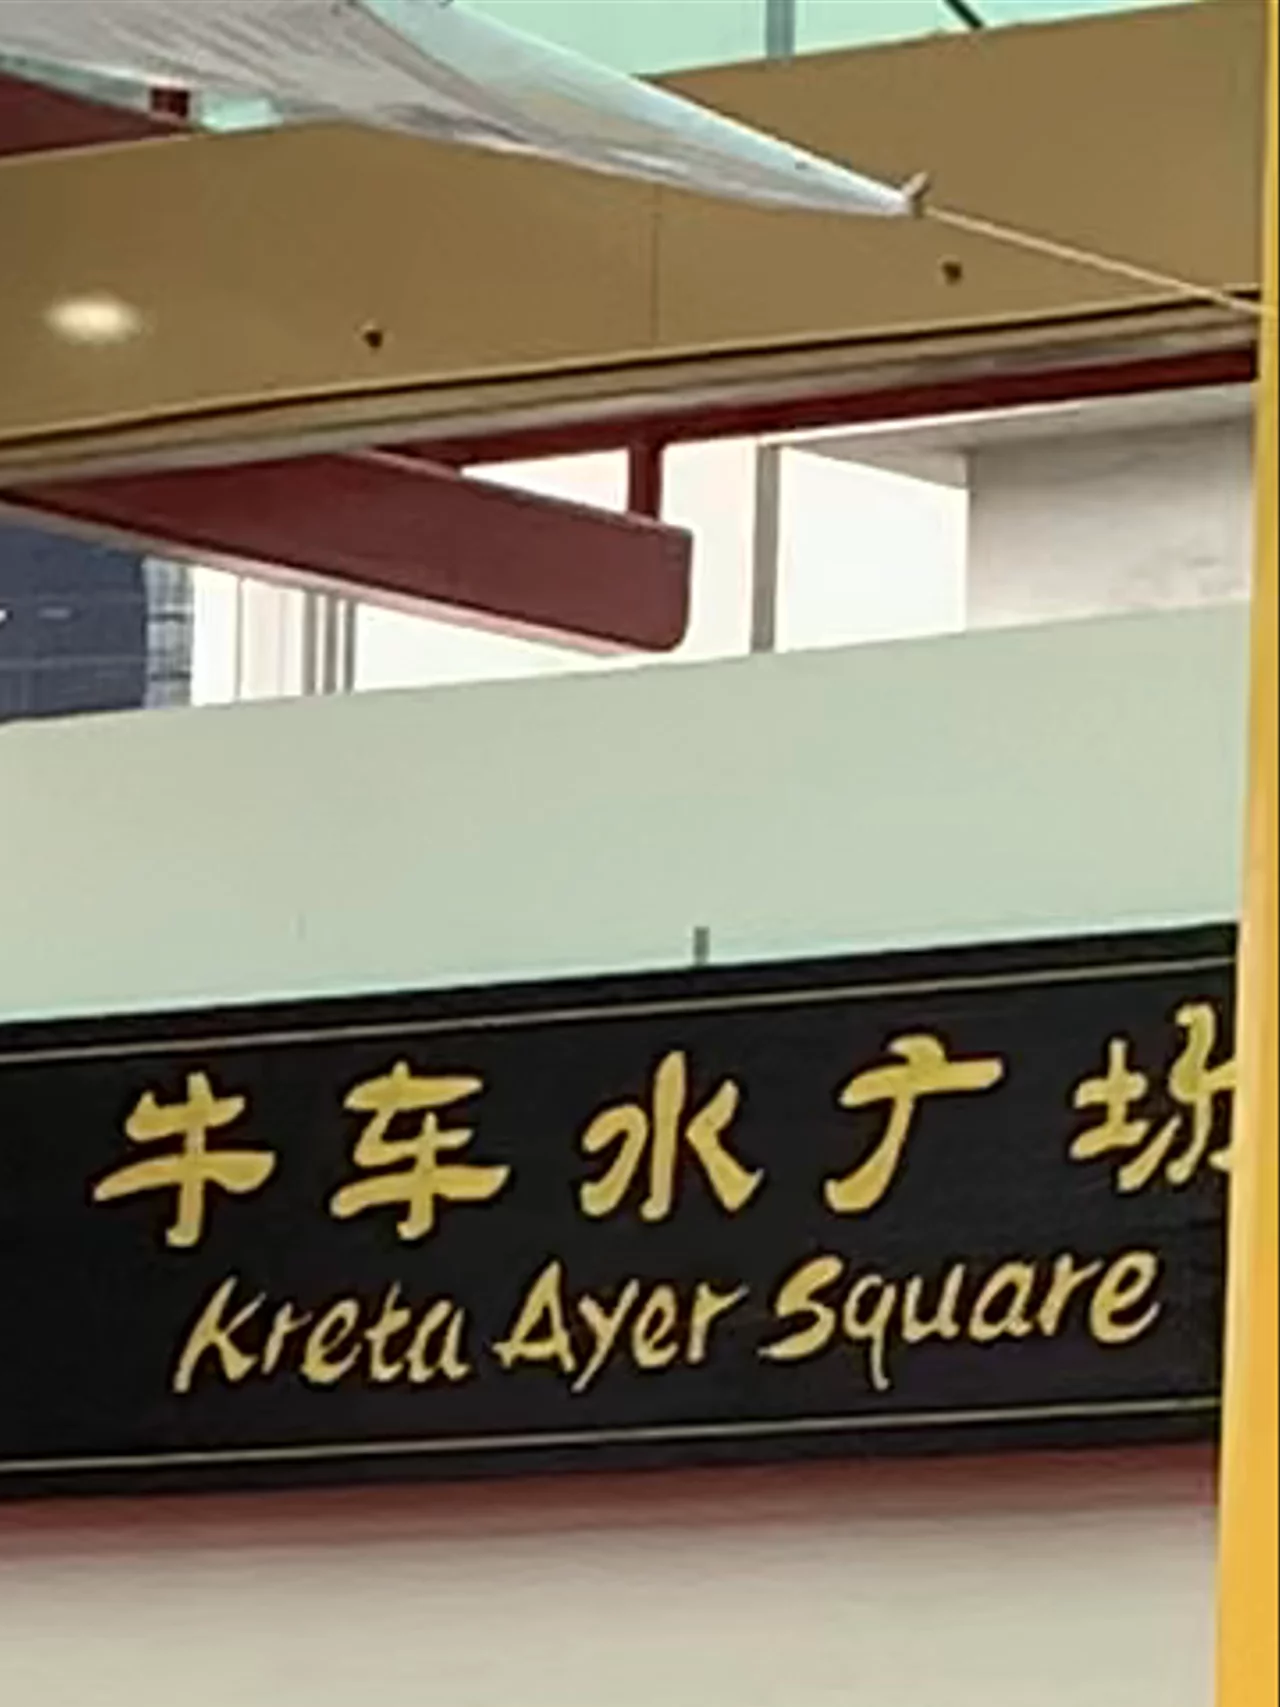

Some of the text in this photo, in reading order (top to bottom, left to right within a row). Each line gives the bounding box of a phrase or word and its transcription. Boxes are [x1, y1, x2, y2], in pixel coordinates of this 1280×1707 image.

[93, 1003, 1236, 1247] 牛车水广场
[172, 1248, 1161, 1393] Kreta Ayer Square
